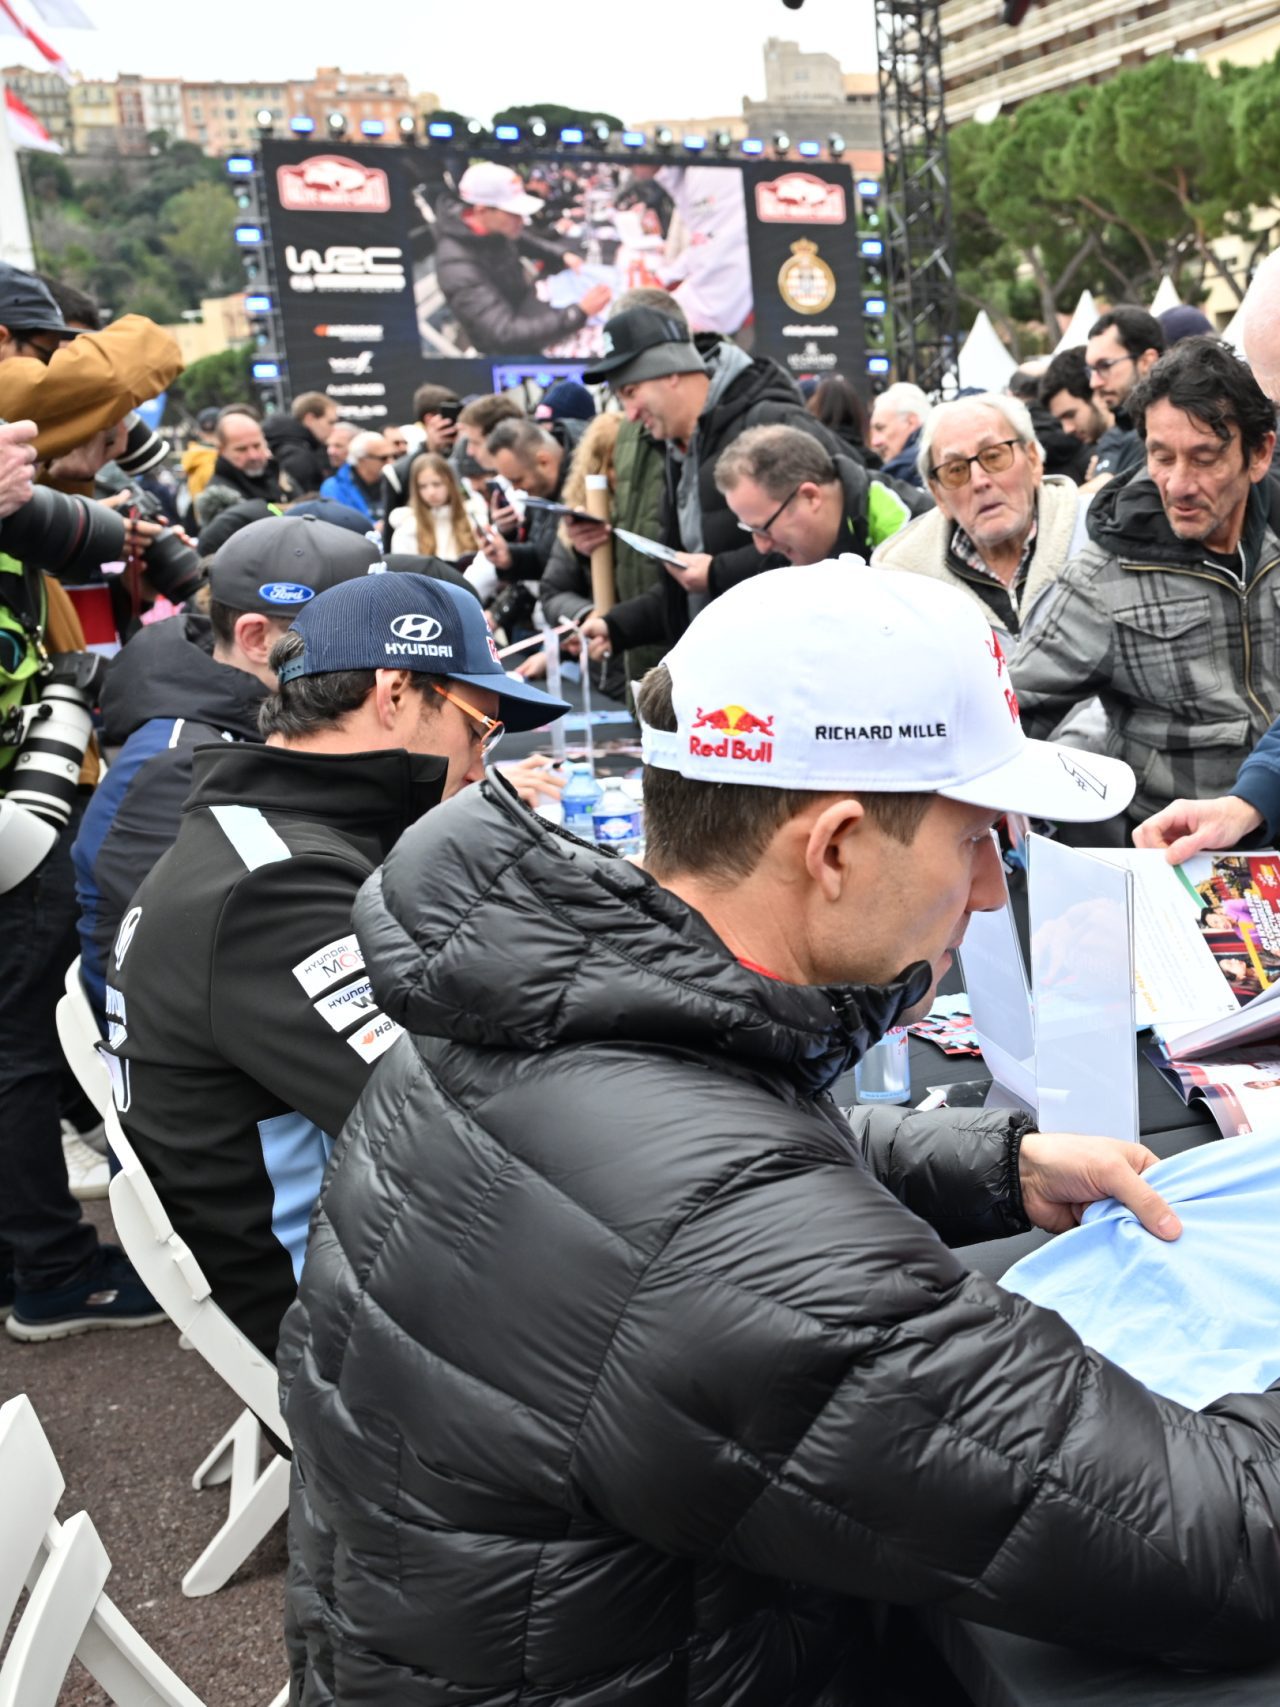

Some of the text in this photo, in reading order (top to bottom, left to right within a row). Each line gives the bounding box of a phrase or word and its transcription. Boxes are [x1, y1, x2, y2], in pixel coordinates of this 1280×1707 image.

[285, 245, 404, 273] WRC
[268, 586, 304, 600] Ford
[385, 643, 453, 658] HYUNDAI
[815, 724, 947, 740] RICHARD MILLE
[690, 736, 773, 763] Red Bull
[304, 945, 348, 975] HYUNDAI
[328, 983, 373, 1009] HYUNDA
